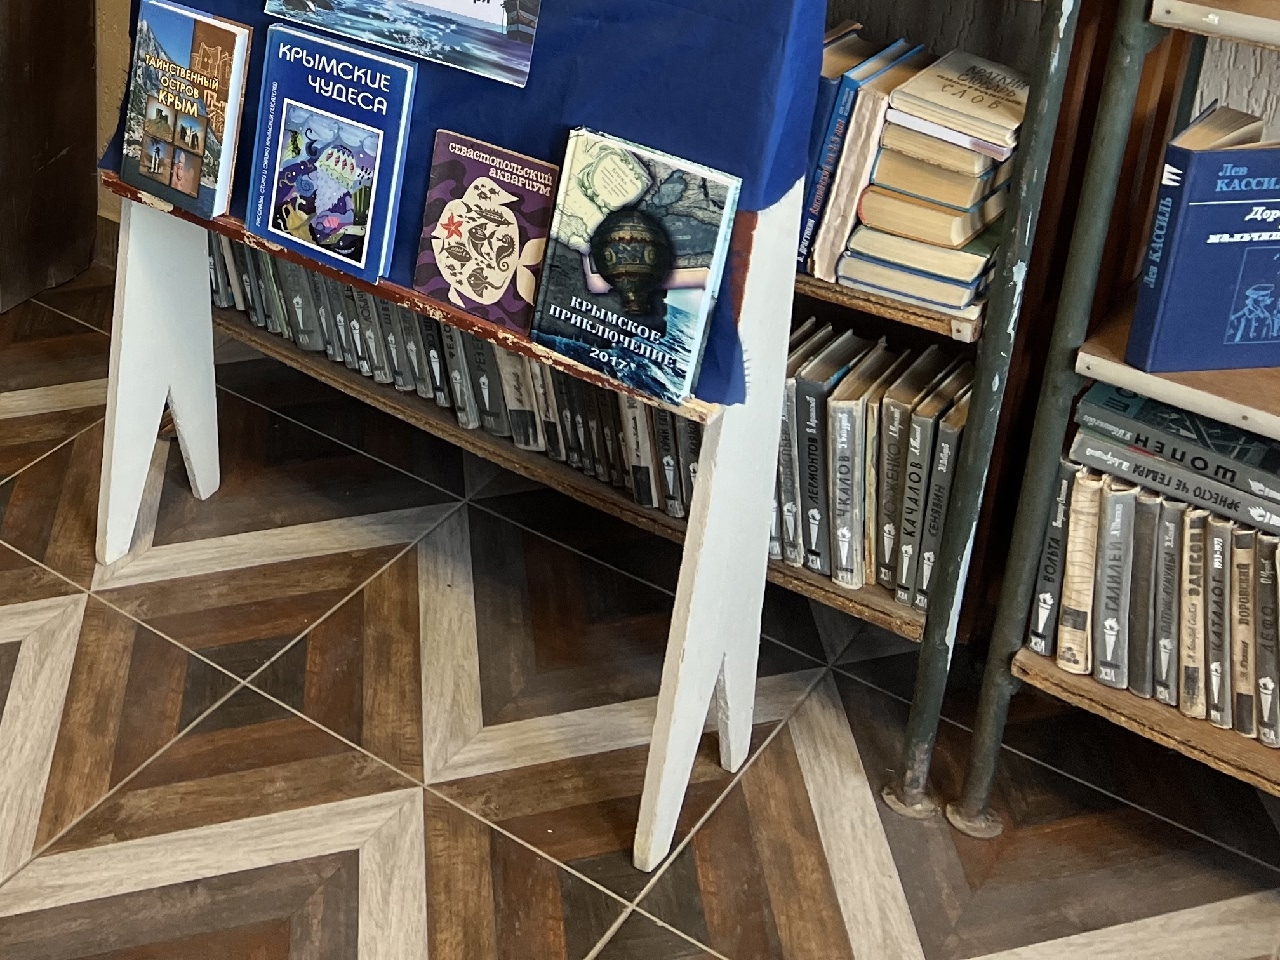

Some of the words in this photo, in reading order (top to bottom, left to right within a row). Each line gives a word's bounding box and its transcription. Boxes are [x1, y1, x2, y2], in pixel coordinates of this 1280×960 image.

[145, 54, 219, 92] ТАИНСТВЕННЫЙ
[160, 75, 199, 100] ОСТРОВ
[278, 42, 392, 93] КРЫМСКИЕ
[158, 90, 199, 118] КРЫМ
[308, 74, 388, 116] ЧУДЕСА
[1219, 164, 1248, 177] Лев
[1149, 196, 1173, 264] КАССИЛЬ
[1142, 267, 1158, 289] Лев
[549, 304, 677, 369] ПРИКЛЮЧЕНИЕ
[570, 295, 662, 345] КРЫМСКОЕ
[589, 347, 627, 371] 2017
[807, 437, 820, 505] ЛЕРМОНТОВ
[1133, 433, 1236, 484] ШОПЕН
[1133, 464, 1173, 488] ГЕВАРА
[835, 454, 851, 517] ЧКАЛОВ
[903, 462, 924, 538] КАЧАЛОВ
[1175, 480, 1190, 495] ЧЕ
[1193, 485, 1241, 512] ЭРНЕСТО
[928, 484, 946, 538] СЕНЯВИН
[1044, 537, 1061, 584] ВОЛЬТА
[1102, 540, 1124, 612] ГАЛИЛЕЙ
[1210, 576, 1227, 653] КАТАЛОГ
[1238, 563, 1251, 626] ВОРОВСКИЙ
[1263, 606, 1277, 655] ДЕФО
